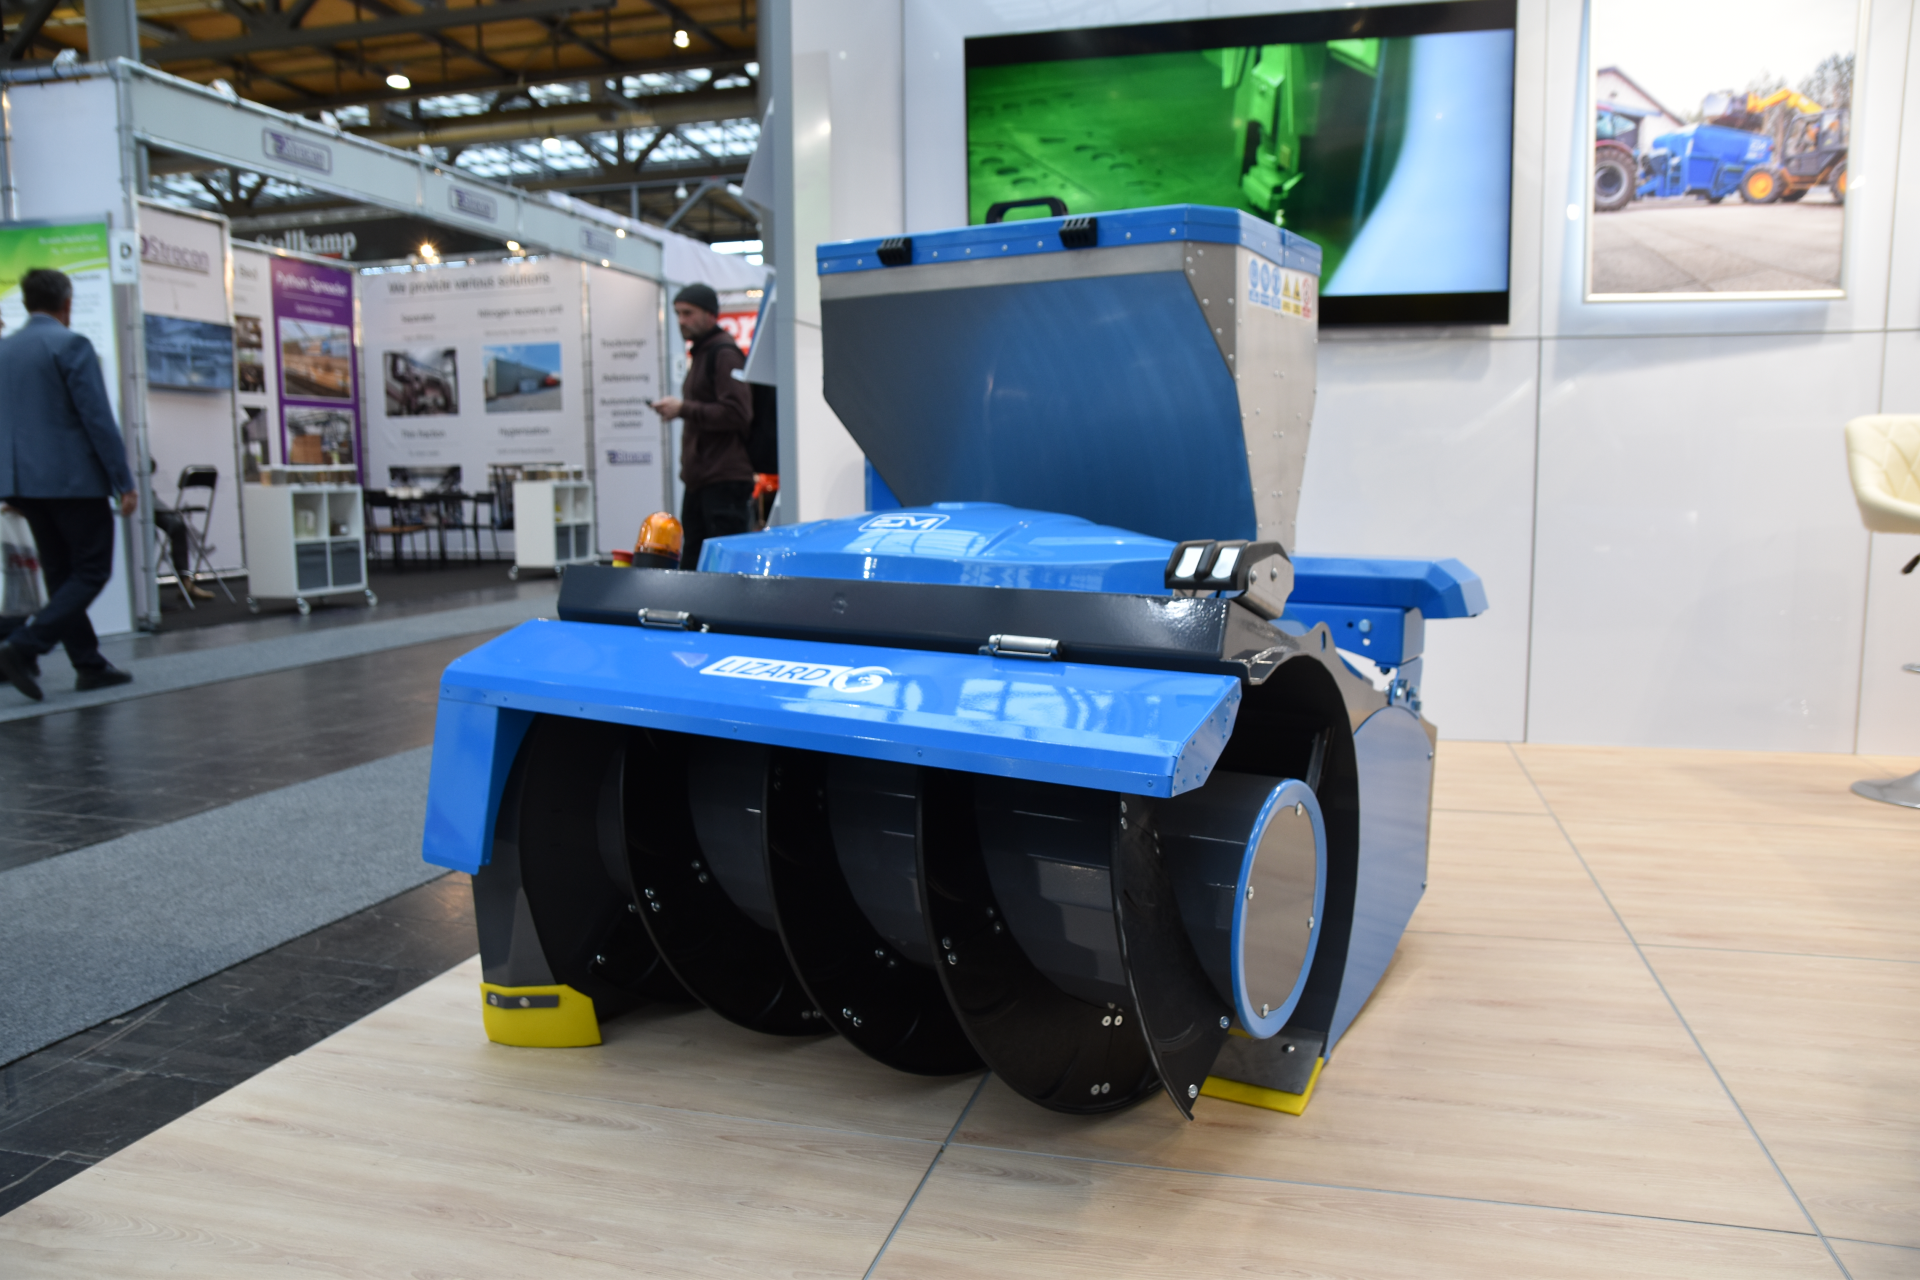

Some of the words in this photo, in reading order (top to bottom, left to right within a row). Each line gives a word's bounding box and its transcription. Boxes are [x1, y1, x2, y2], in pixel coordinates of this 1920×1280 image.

[409, 278, 450, 295] provide
[455, 275, 494, 290] various
[499, 272, 550, 287] solutions
[713, 658, 830, 682] LIZARD
